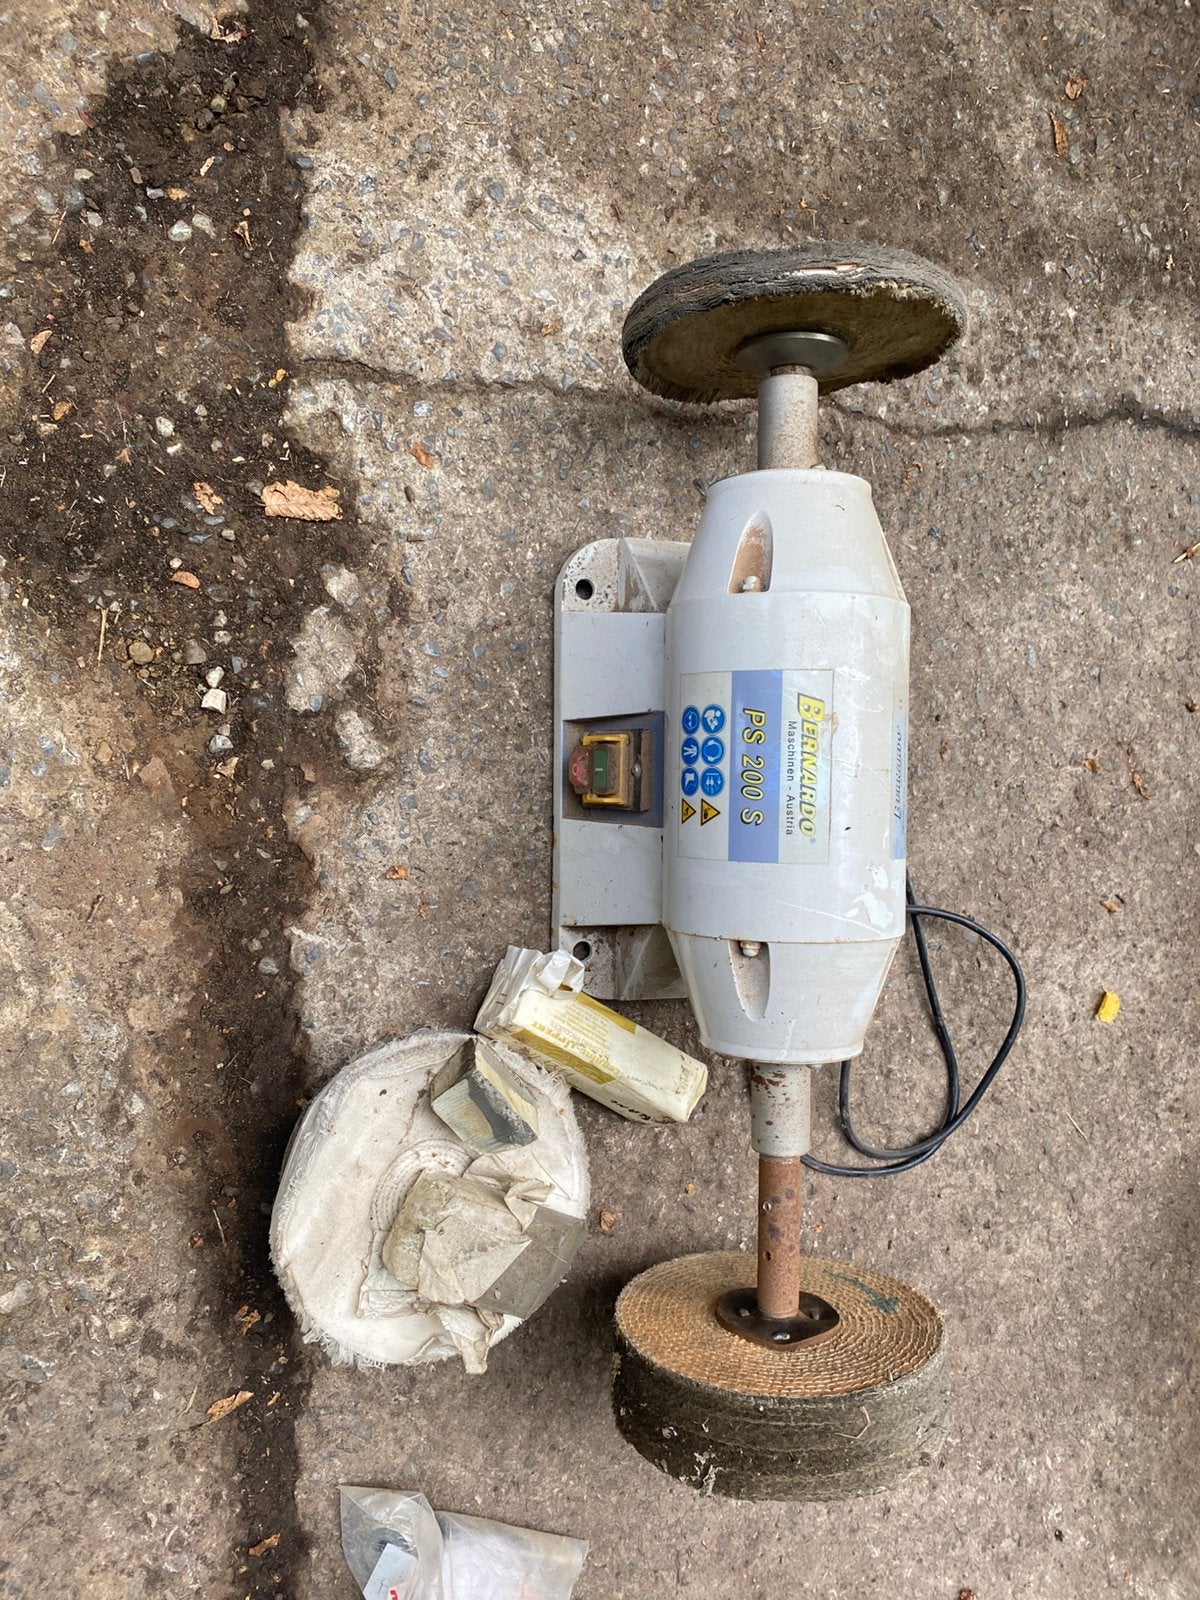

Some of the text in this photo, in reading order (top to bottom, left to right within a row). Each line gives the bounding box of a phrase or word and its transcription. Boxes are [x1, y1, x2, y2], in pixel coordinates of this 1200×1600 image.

[740, 708, 766, 827] PS 200 S
[786, 720, 797, 782] Maschinen
[797, 693, 824, 837] BERNARDO
[786, 794, 796, 836] Austria
